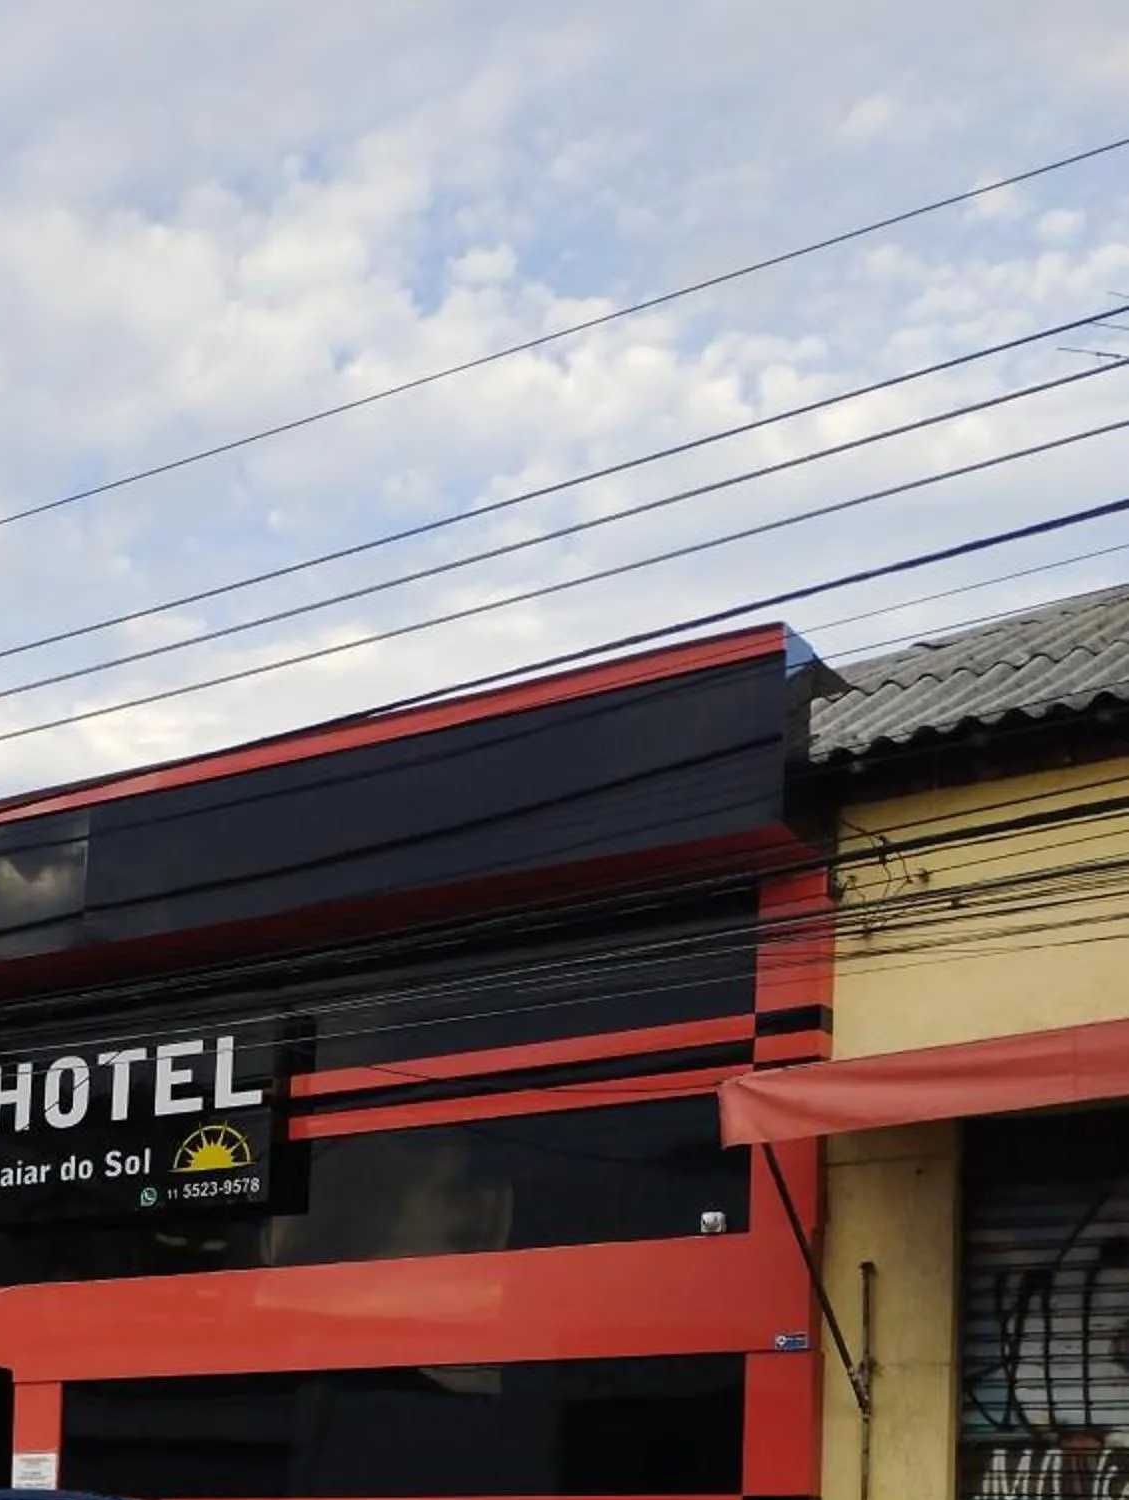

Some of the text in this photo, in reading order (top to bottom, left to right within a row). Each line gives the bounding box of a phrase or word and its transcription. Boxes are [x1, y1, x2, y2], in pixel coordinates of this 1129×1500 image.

[60, 1155, 93, 1182] do
[104, 1148, 151, 1178] Sol
[182, 1177, 260, 1199] 5523-9578
